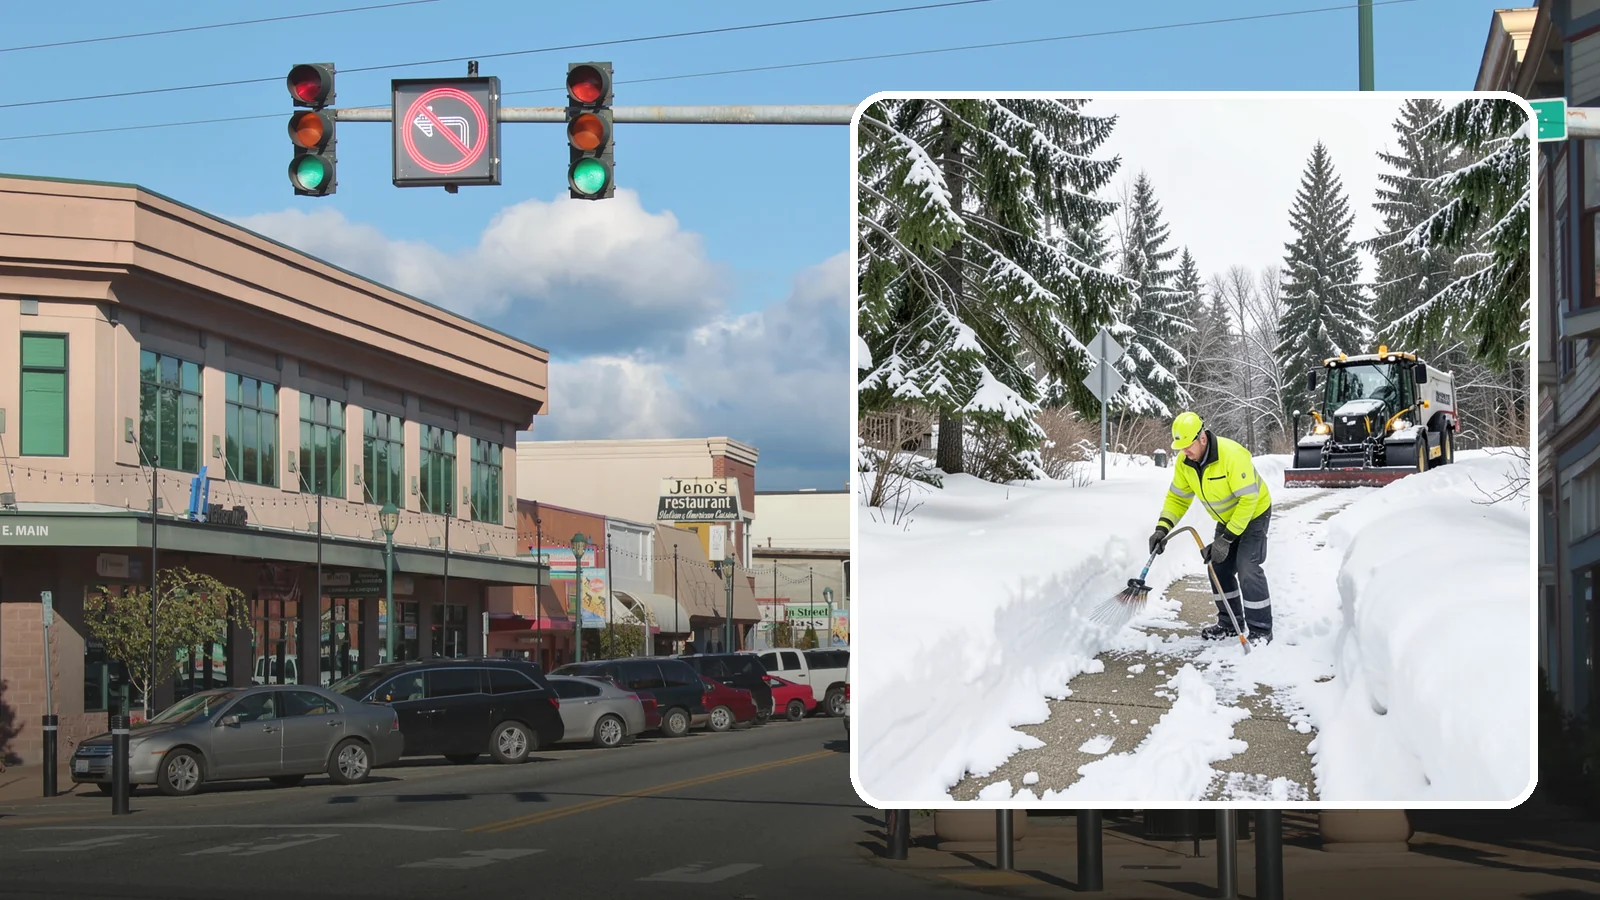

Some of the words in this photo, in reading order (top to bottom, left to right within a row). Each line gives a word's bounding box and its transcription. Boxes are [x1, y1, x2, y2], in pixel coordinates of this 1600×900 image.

[669, 480, 727, 494] Jeno's
[665, 496, 731, 509] restaurant
[658, 510, 682, 520] Italian
[686, 510, 715, 519] American
[715, 509, 738, 519] Cuisine
[2, 525, 13, 536] E.
[15, 525, 49, 536] MAIN
[797, 607, 829, 617] Street
